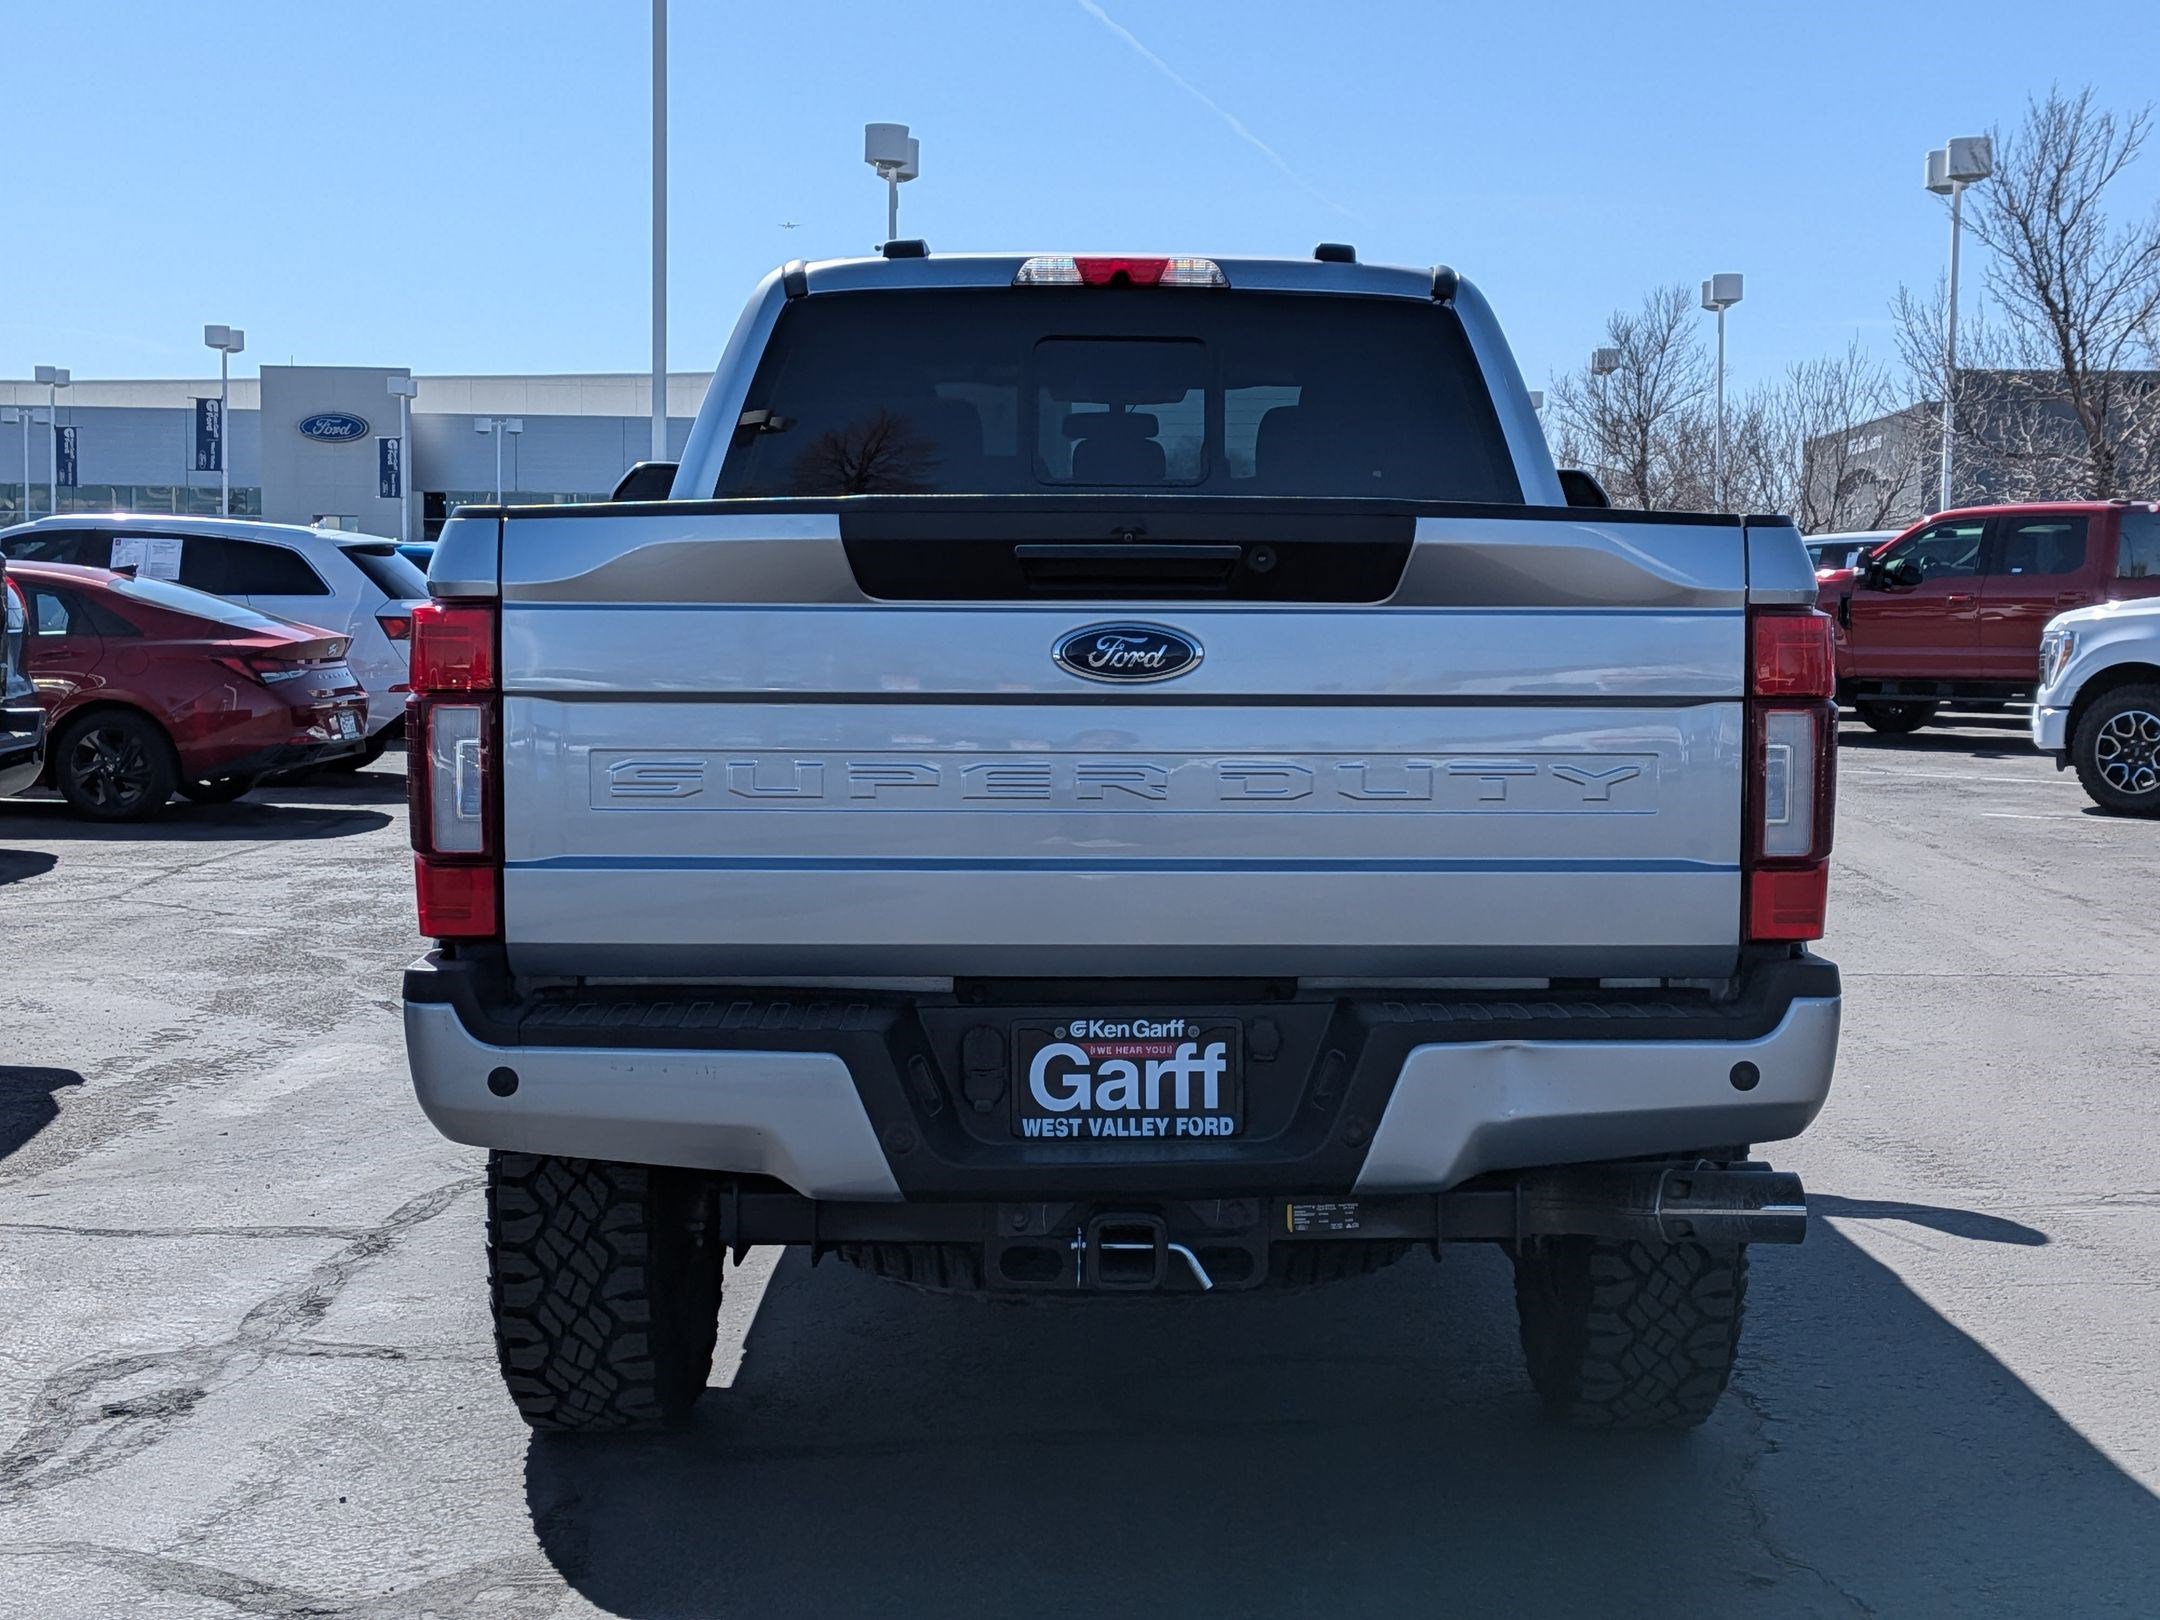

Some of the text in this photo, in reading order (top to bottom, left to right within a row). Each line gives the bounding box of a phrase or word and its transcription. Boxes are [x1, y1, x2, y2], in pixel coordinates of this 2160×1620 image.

[312, 419, 351, 435] Ford
[1088, 635, 1168, 668] Ford
[608, 761, 1642, 801] SUPER DUTY
[1096, 1045, 1165, 1055] WE HEAR YOU
[1029, 1042, 1227, 1112] Garff
[1022, 1117, 1234, 1137] WEST VALLEY FORD
